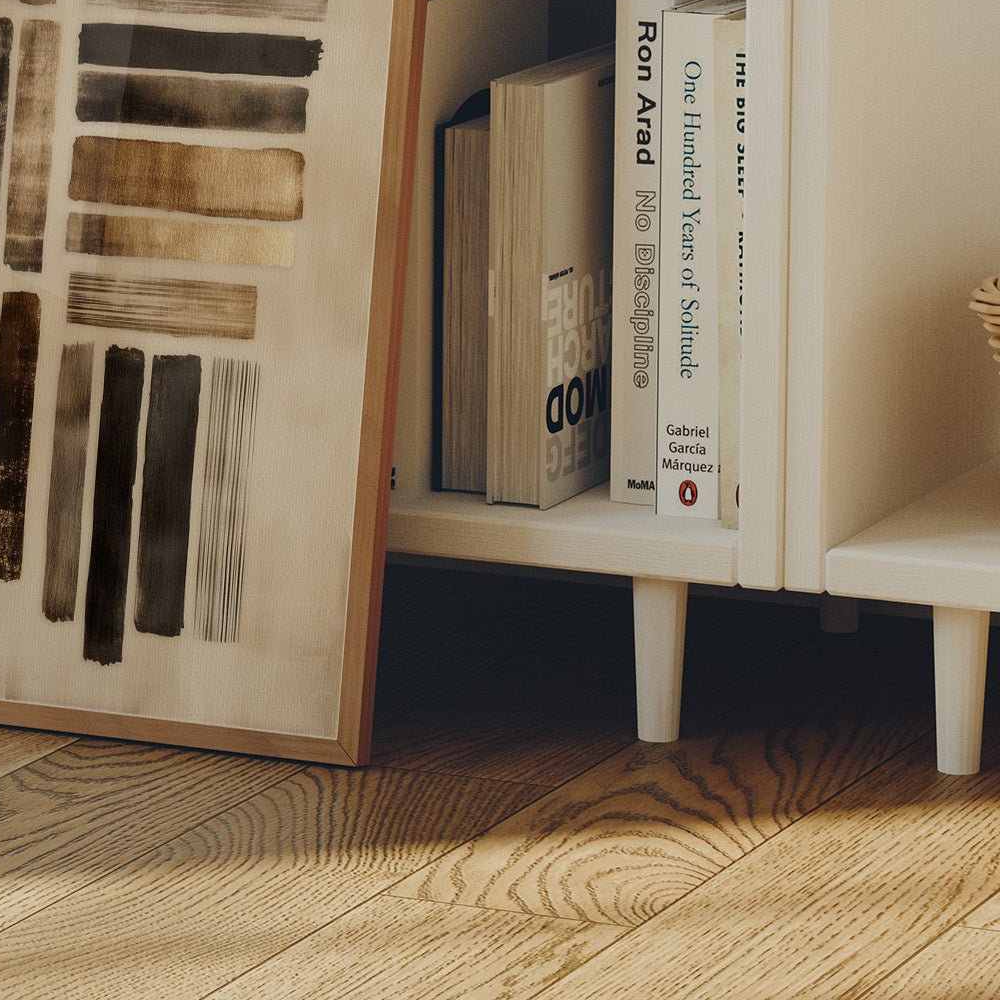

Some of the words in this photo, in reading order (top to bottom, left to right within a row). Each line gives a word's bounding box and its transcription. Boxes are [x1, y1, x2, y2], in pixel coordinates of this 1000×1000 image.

[637, 21, 657, 82] Ron
[684, 61, 702, 104] One
[636, 92, 657, 165] Arad
[682, 112, 702, 200] Hundred
[635, 190, 656, 232] No
[681, 207, 701, 261] Years
[681, 268, 700, 292] of
[630, 243, 656, 389] Discipline
[680, 299, 700, 379] Solitude
[546, 365, 607, 434] MOD
[666, 424, 709, 438] Gabriel
[668, 441, 706, 456] García
[627, 479, 655, 491] MoMA
[662, 458, 713, 473] Márquez
